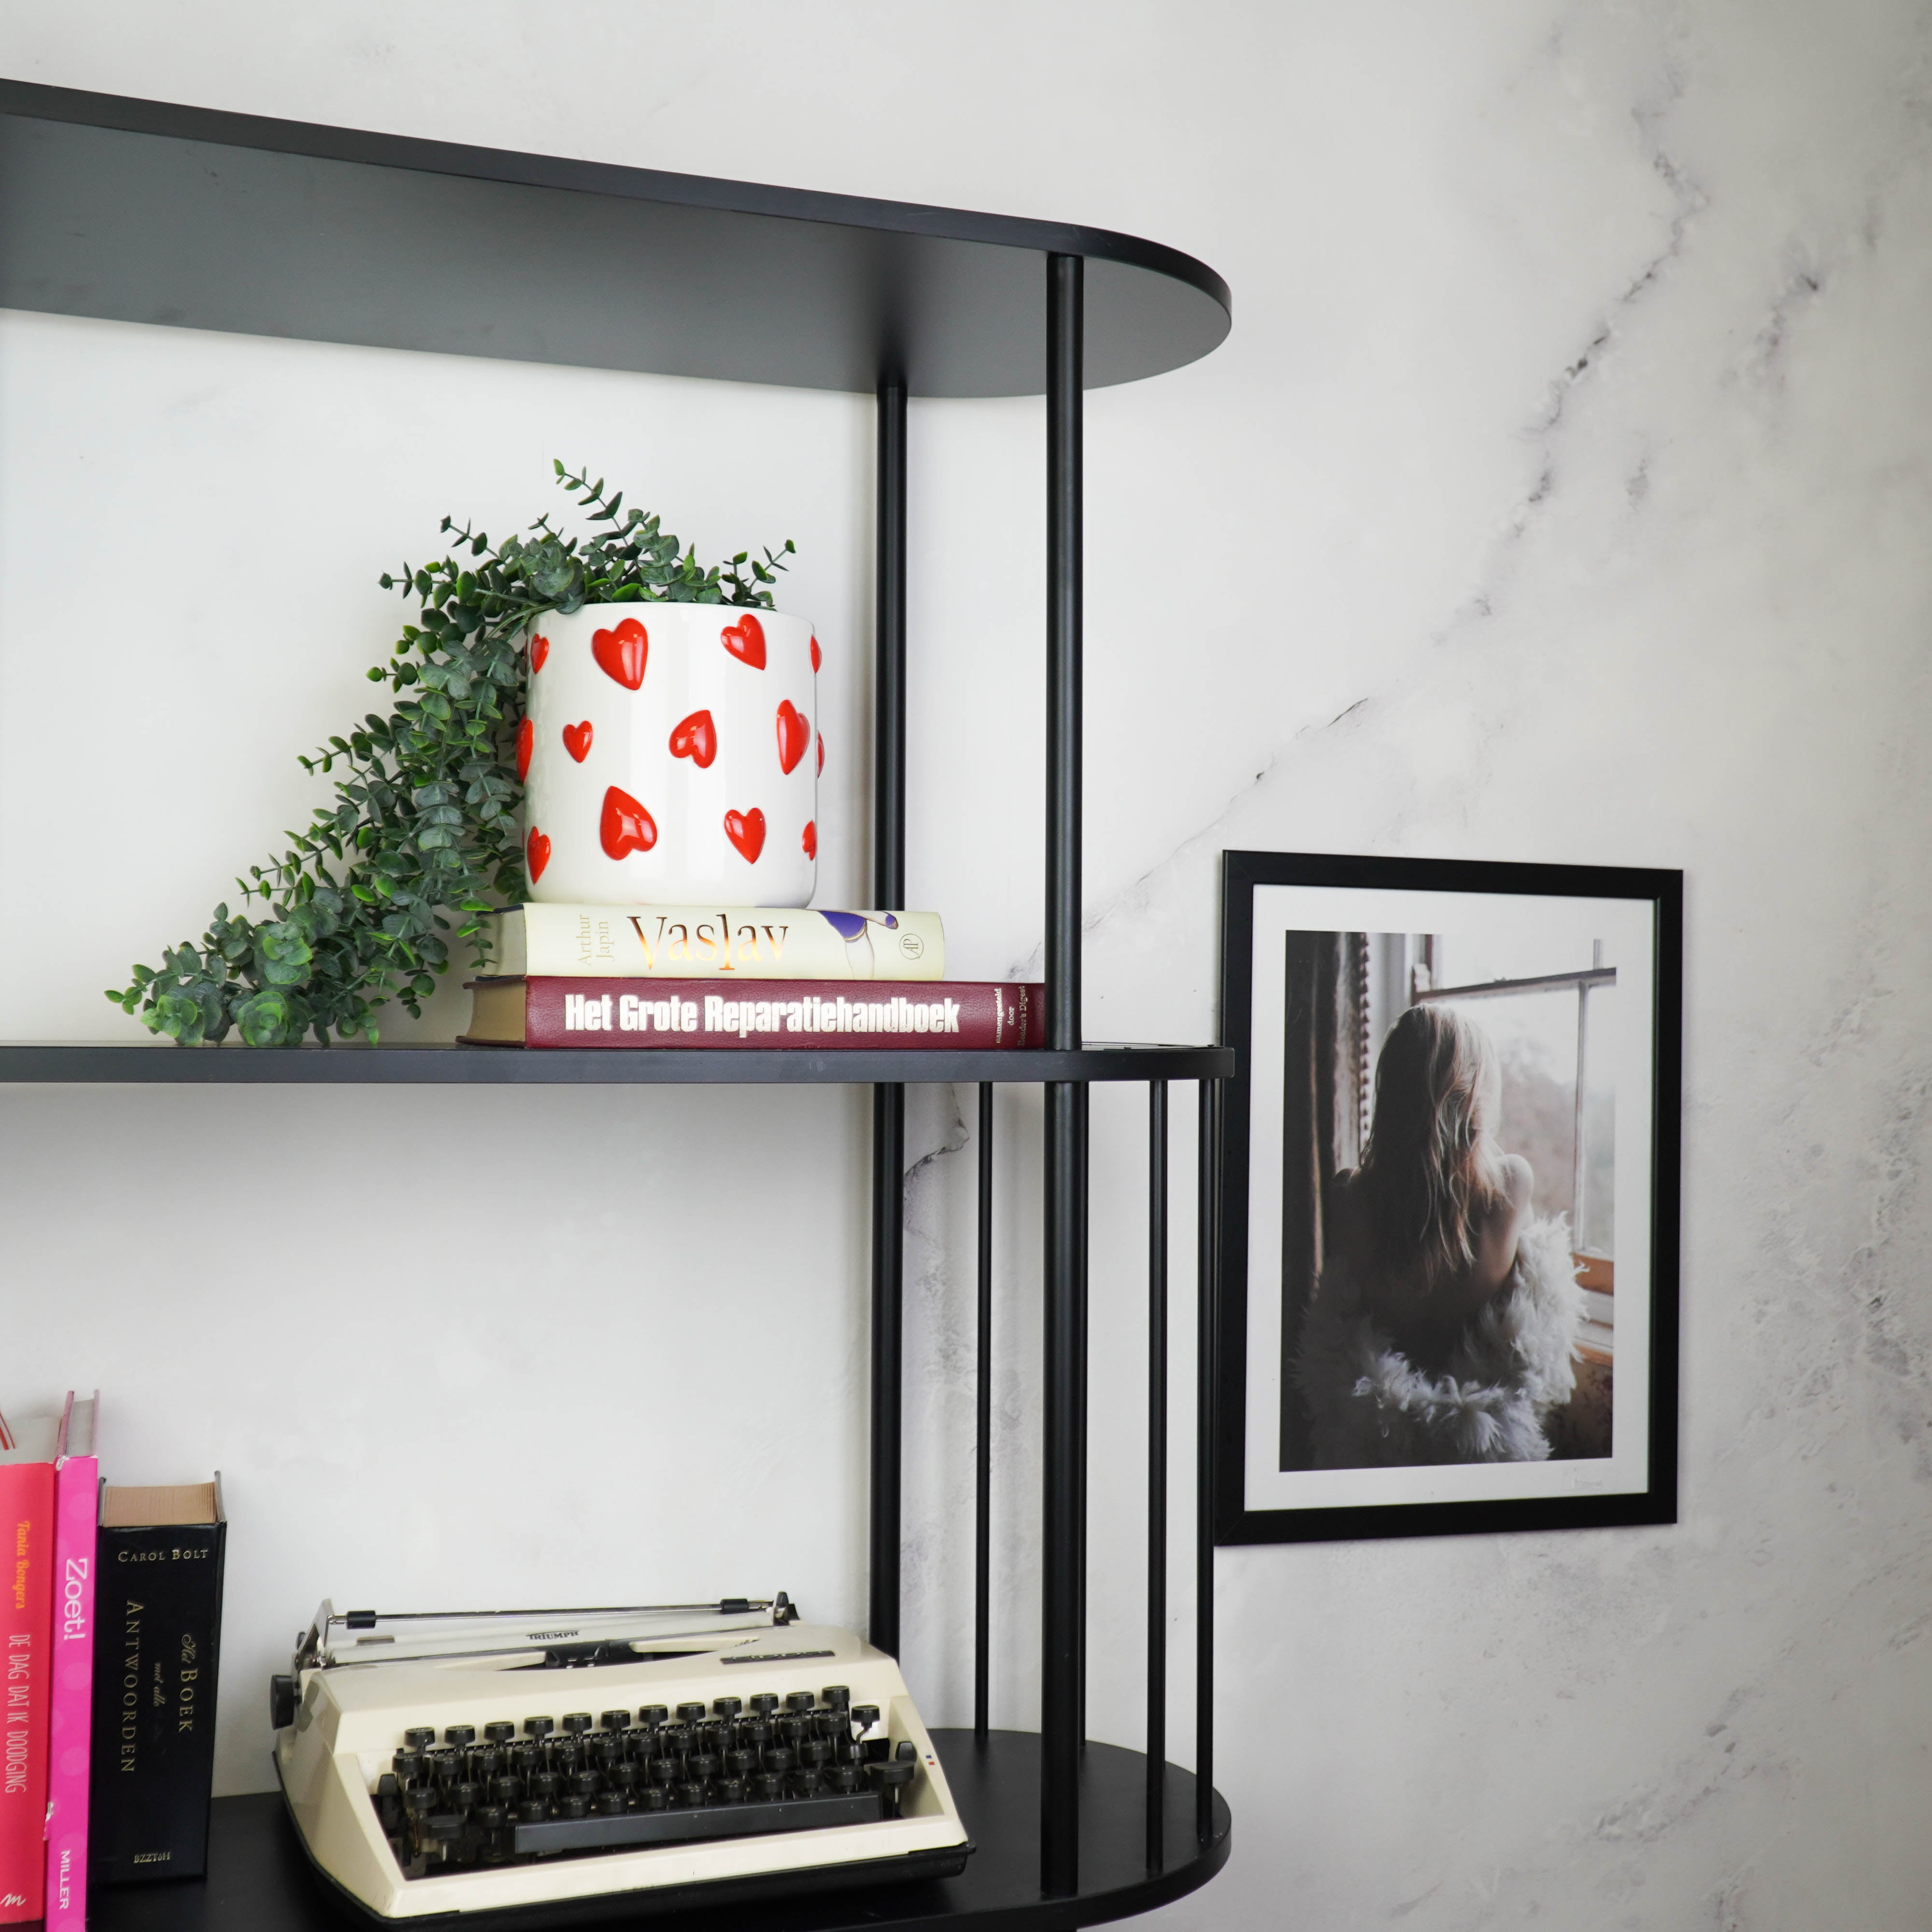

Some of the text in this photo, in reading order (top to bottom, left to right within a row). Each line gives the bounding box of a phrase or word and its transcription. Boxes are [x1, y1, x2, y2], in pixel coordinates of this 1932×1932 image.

[576, 914, 592, 966] Arthur
[595, 920, 614, 962] Japin
[626, 913, 789, 971] Vaslav
[565, 994, 960, 1038] Het Grote Reparatiehandboek
[994, 988, 1004, 1043] Samengesteld
[1017, 986, 1028, 1046] Reader's Digest
[12, 1520, 30, 1609] Tania Bongers
[118, 1549, 208, 1562] CAROL BOLT
[64, 1558, 88, 1640] Zoet!
[526, 1630, 580, 1640] TRIUMPH
[5, 1634, 30, 1793] DE DAG DAT IK DOODGING
[121, 1600, 144, 1773] ANTWOORDEN
[179, 1668, 198, 1733] BOEK
[59, 1849, 71, 1910] MILLER
